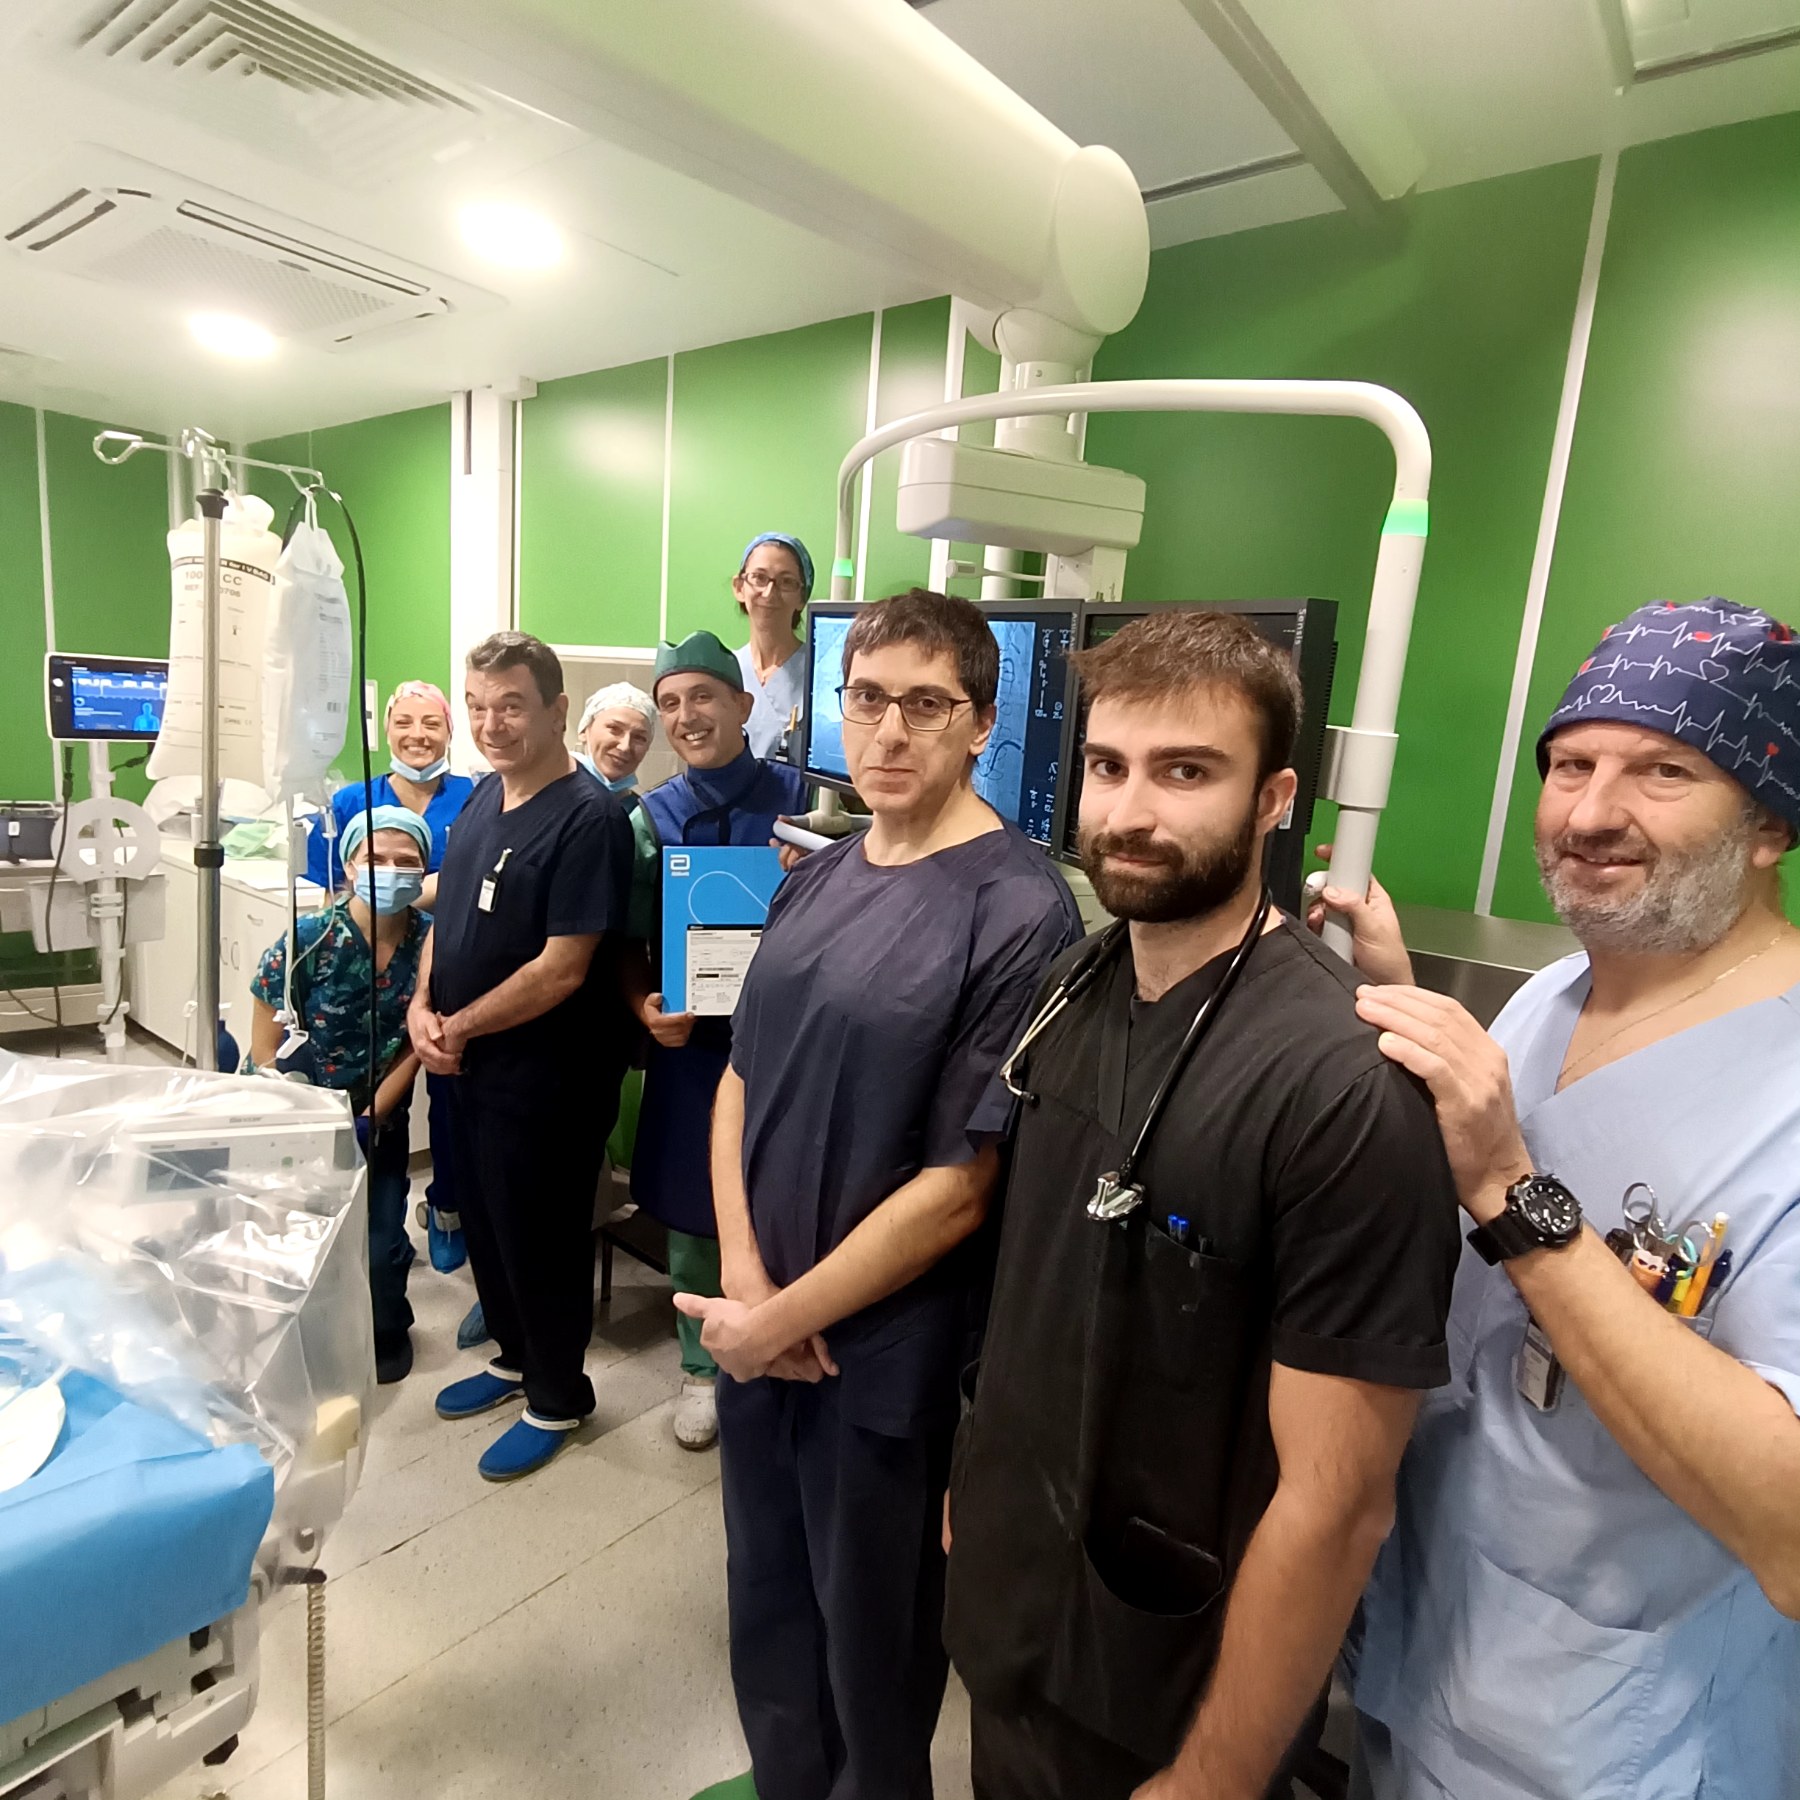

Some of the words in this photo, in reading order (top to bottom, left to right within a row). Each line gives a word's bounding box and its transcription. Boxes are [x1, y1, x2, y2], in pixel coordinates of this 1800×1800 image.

[185, 571, 203, 579] 100
[222, 574, 242, 586] CC
[252, 568, 270, 580] BAG
[1294, 608, 1307, 645] Sensis
